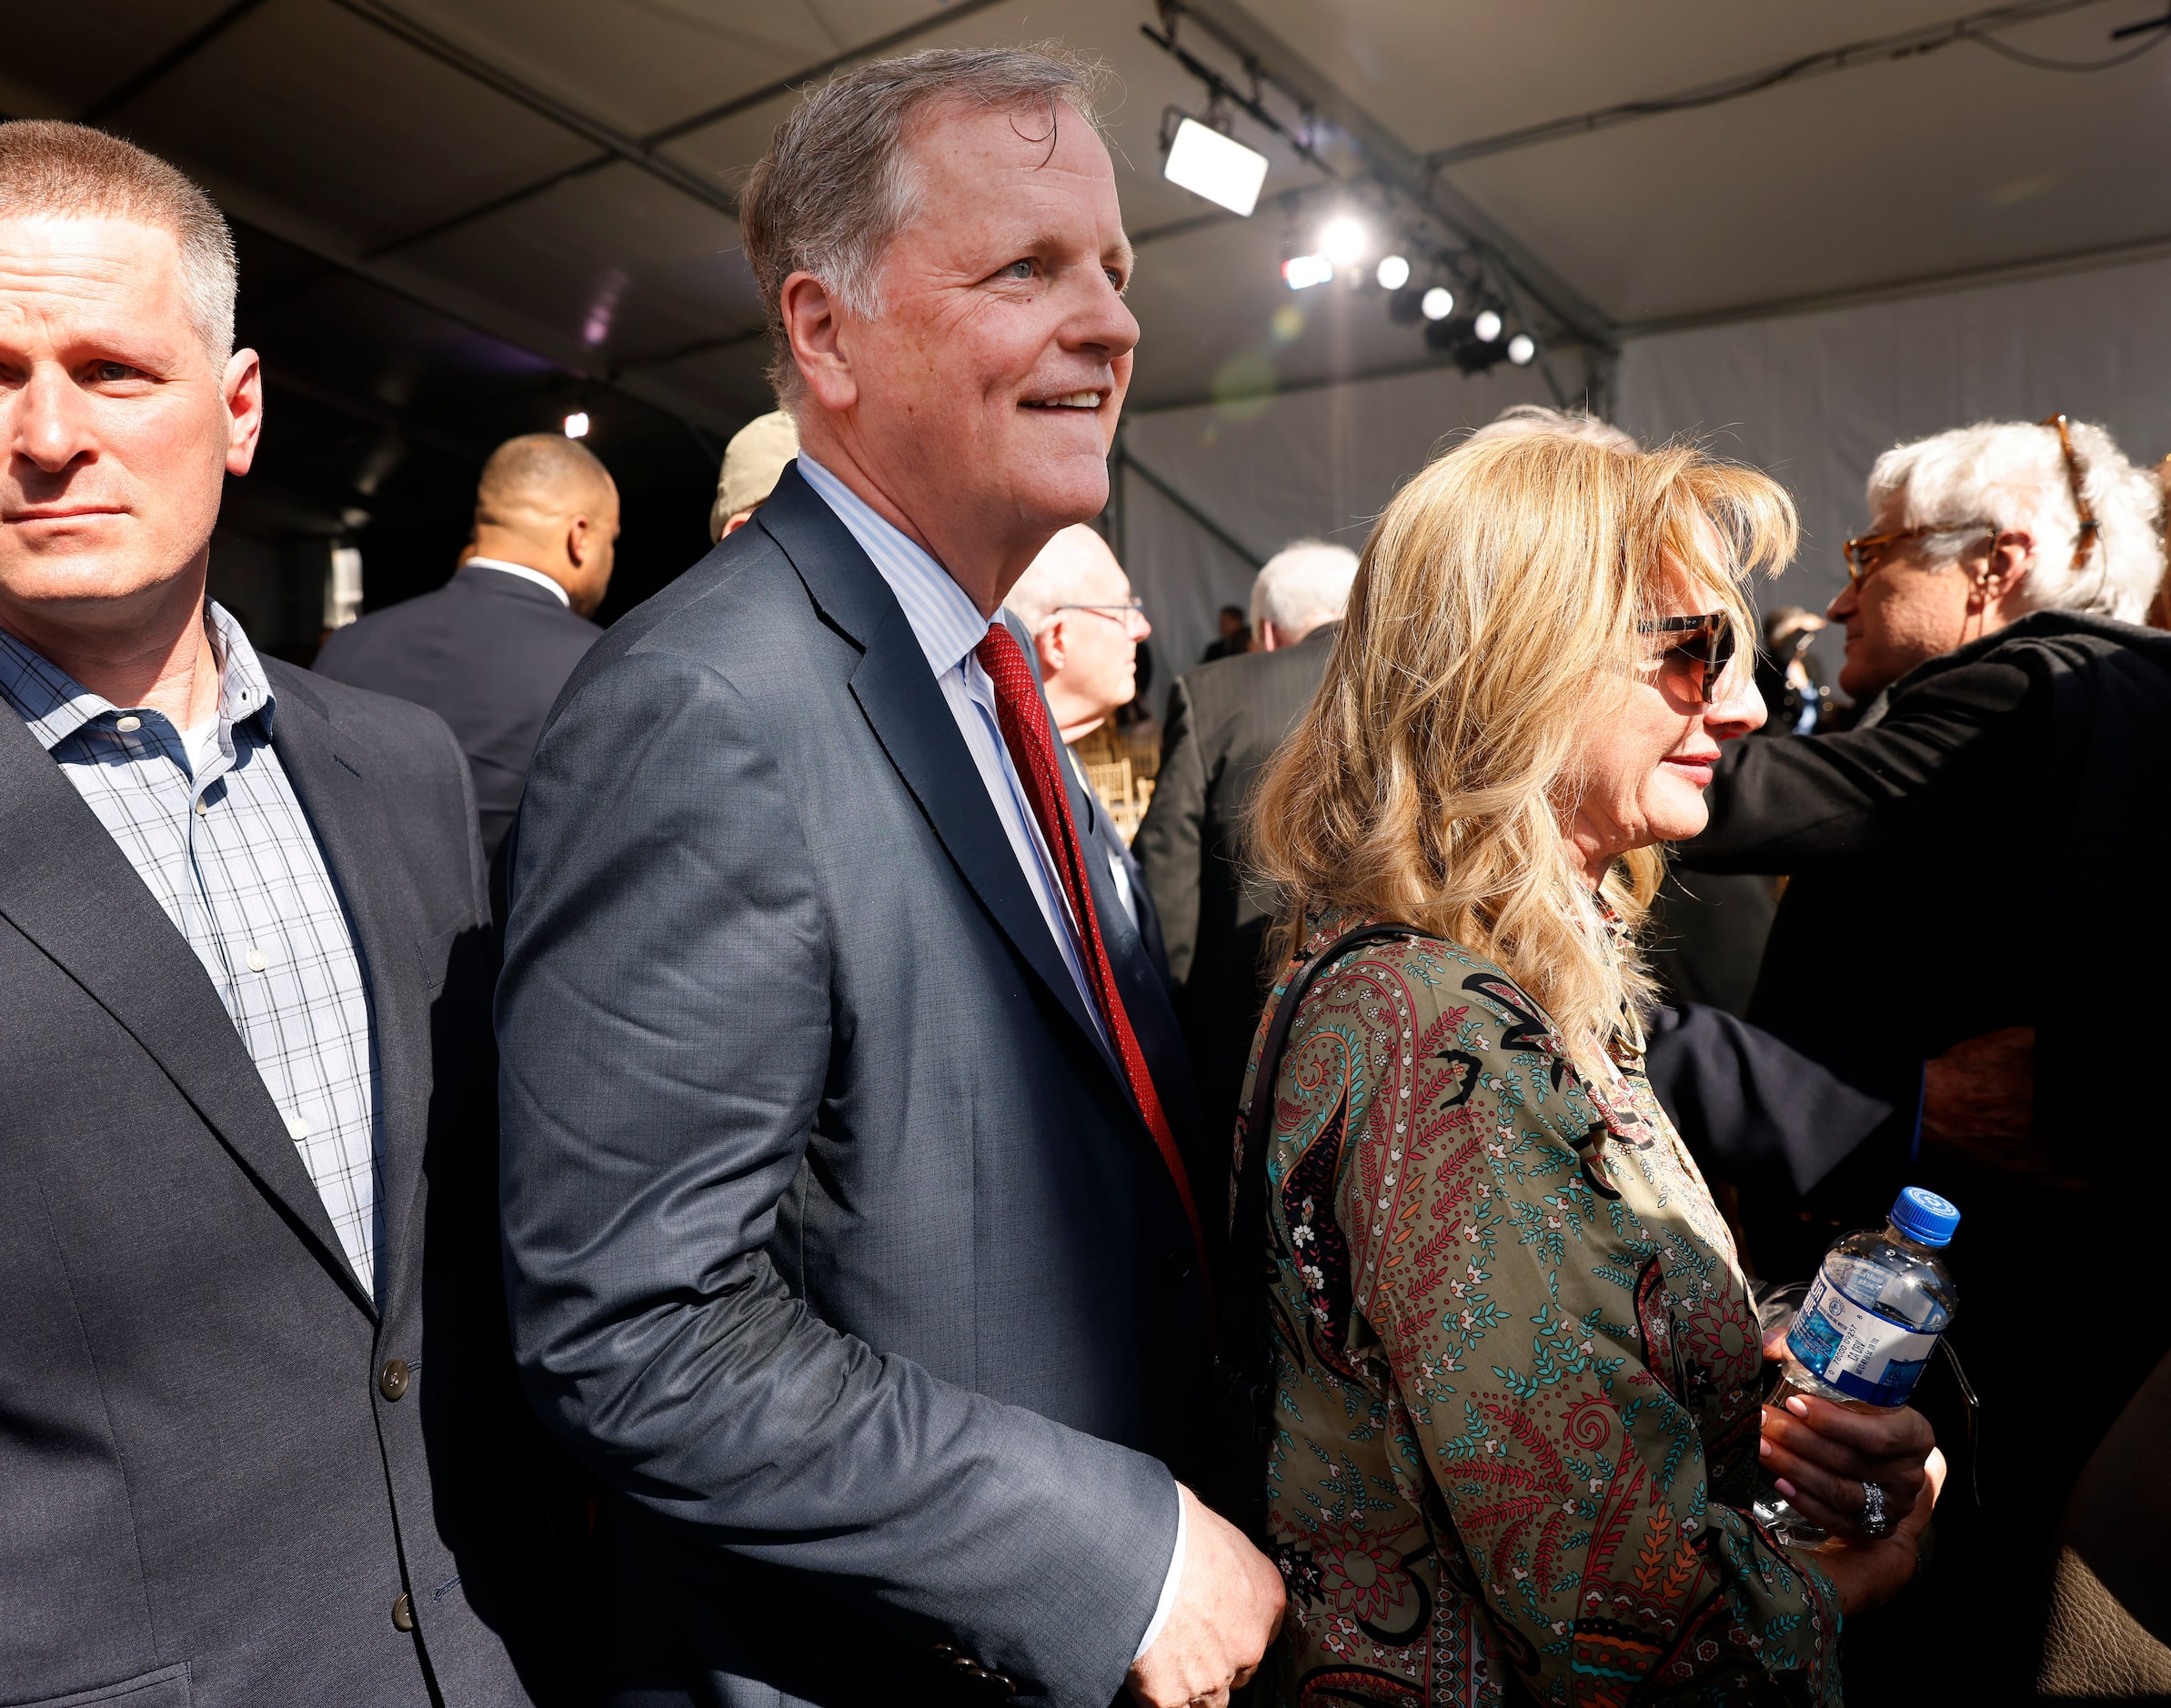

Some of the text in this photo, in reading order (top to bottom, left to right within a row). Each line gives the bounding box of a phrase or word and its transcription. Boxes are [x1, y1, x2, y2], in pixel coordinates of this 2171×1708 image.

[1833, 1344, 1847, 1365] 78000
[1843, 1323, 1857, 1345] 09257
[1847, 1340, 1865, 1362] CA CRV
